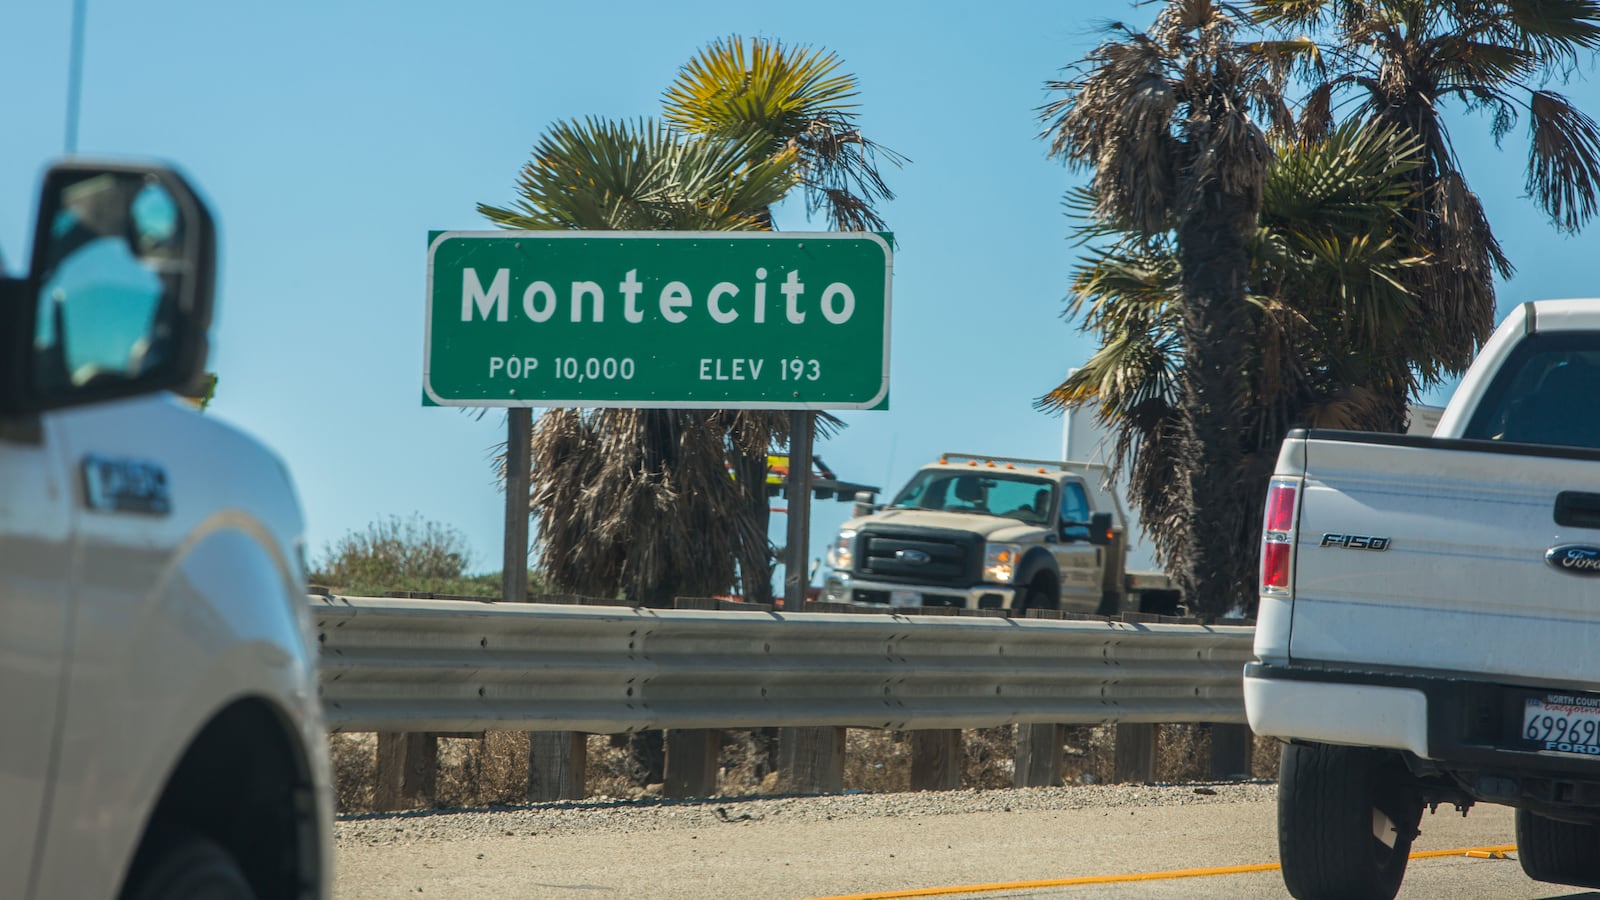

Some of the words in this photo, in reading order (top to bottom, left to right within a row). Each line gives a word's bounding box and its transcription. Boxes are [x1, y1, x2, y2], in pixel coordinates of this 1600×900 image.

[460, 267, 855, 324] Montecito
[489, 356, 539, 379] POP
[554, 357, 636, 383] 10,000
[699, 358, 764, 381] ELEV
[780, 358, 821, 381] 193
[1547, 695, 1574, 705] NORTH
[1527, 715, 1600, 745] 69969
[1545, 742, 1600, 754] FORD
